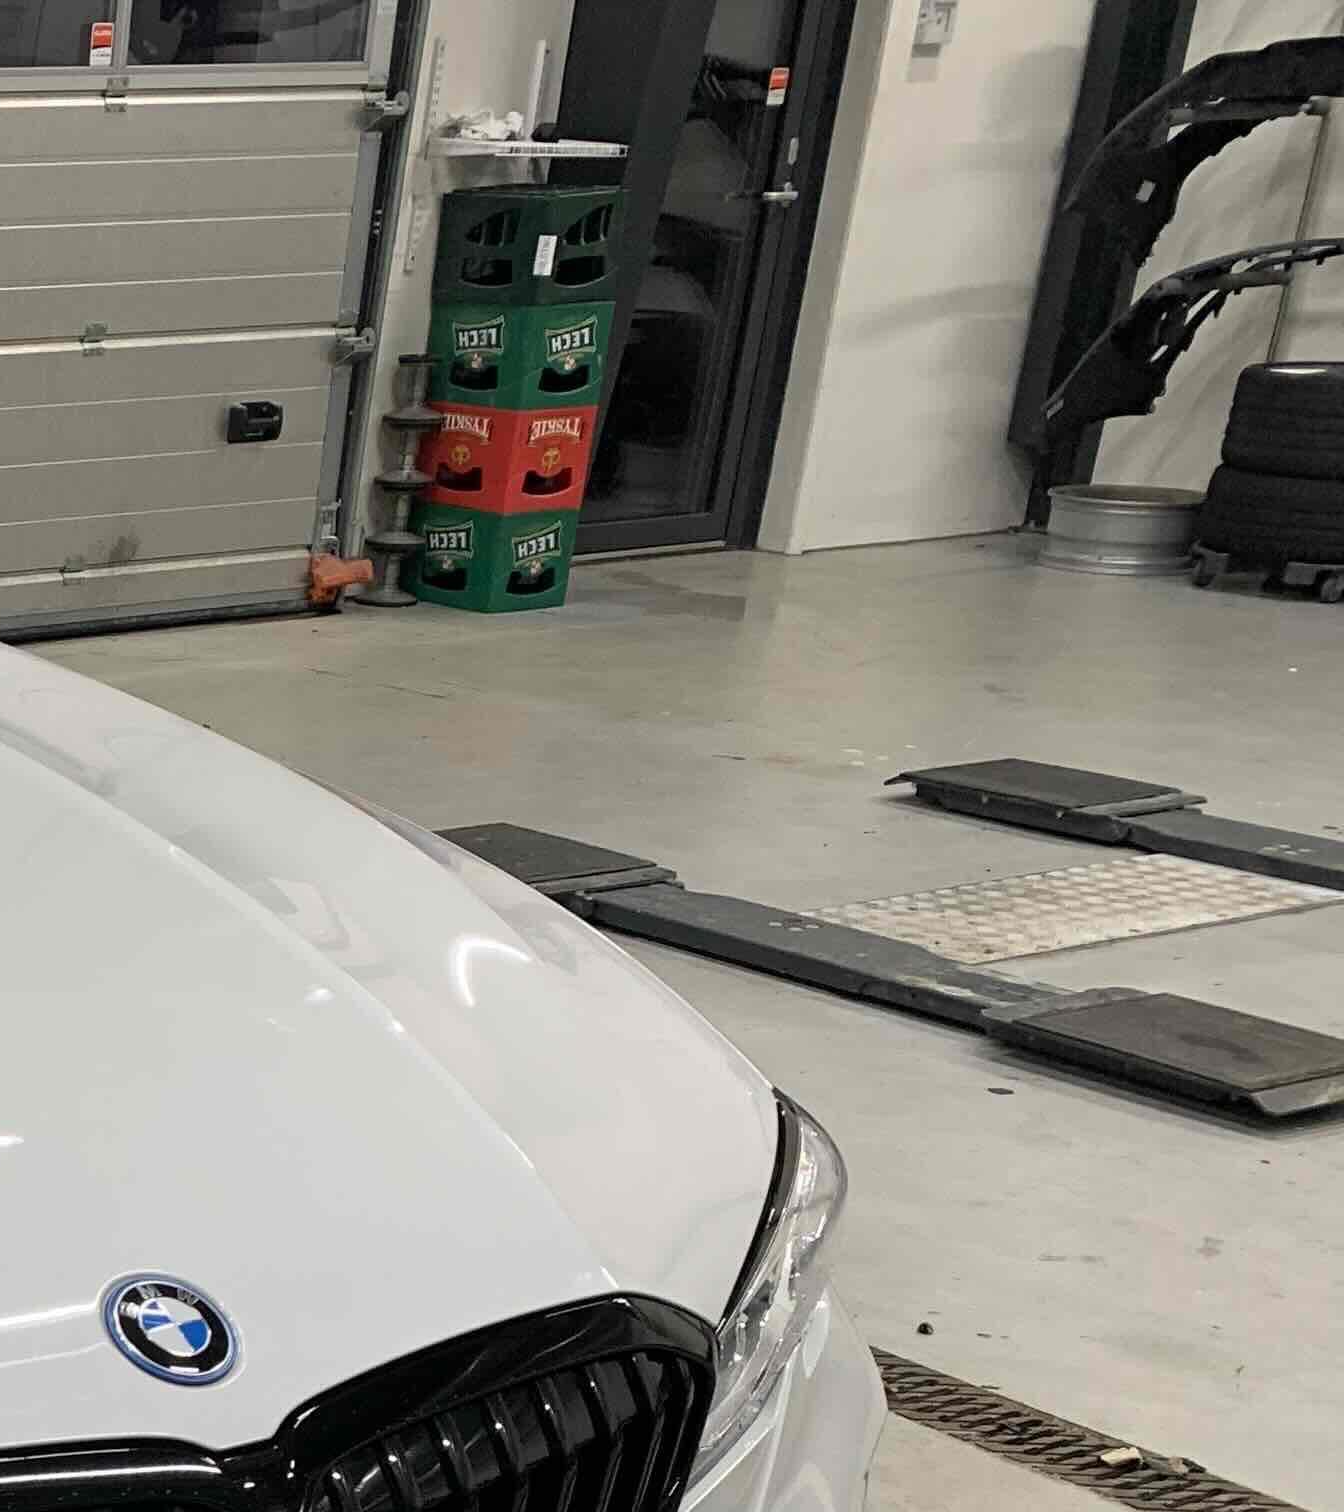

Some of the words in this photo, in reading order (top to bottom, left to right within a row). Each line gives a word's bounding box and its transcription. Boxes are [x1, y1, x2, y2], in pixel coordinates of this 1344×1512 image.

[458, 327, 497, 348] LECH
[551, 326, 591, 353] LECH
[441, 412, 491, 439] TYSKIE
[530, 415, 582, 443] TYSKIE
[429, 531, 467, 549] LECH
[518, 532, 555, 557] LECH
